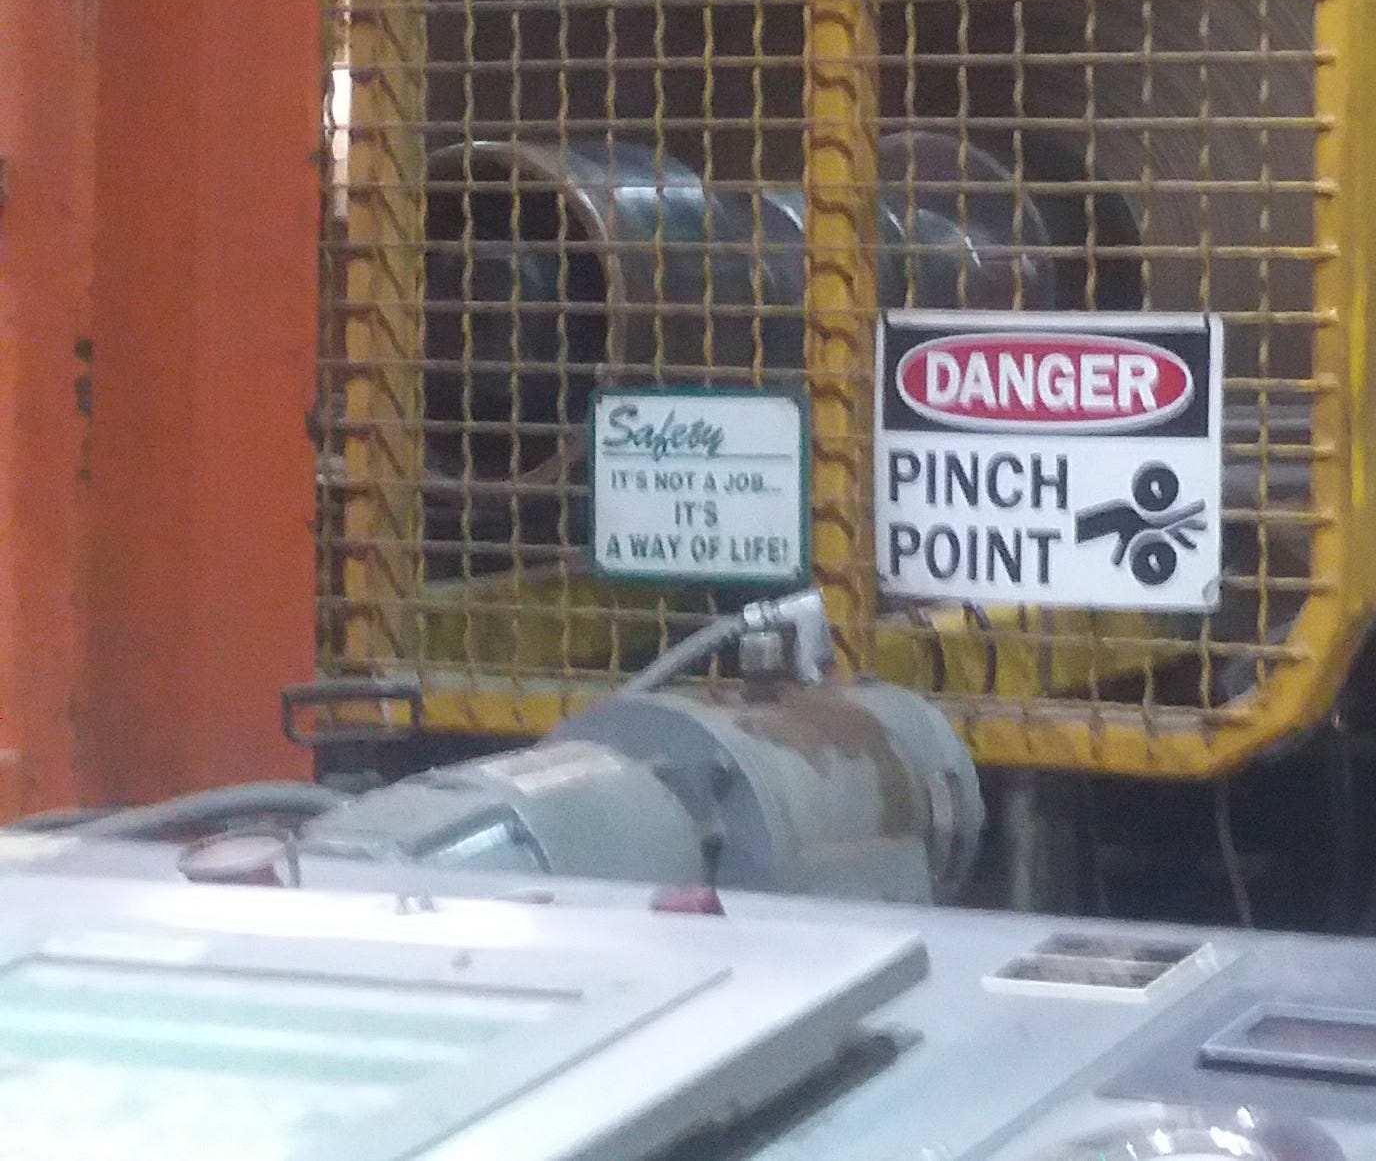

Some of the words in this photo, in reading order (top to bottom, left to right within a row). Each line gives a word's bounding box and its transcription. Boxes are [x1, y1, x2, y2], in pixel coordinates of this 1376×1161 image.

[925, 351, 1158, 413] DANGER
[602, 403, 725, 462] Safety
[654, 470, 696, 491] NOT
[703, 470, 718, 491] A
[887, 448, 1069, 510] PINCH
[606, 533, 622, 559] A
[628, 533, 682, 560] WAY
[690, 534, 720, 563] OF
[730, 535, 789, 563] LIFE!
[887, 521, 1062, 586] POINT
